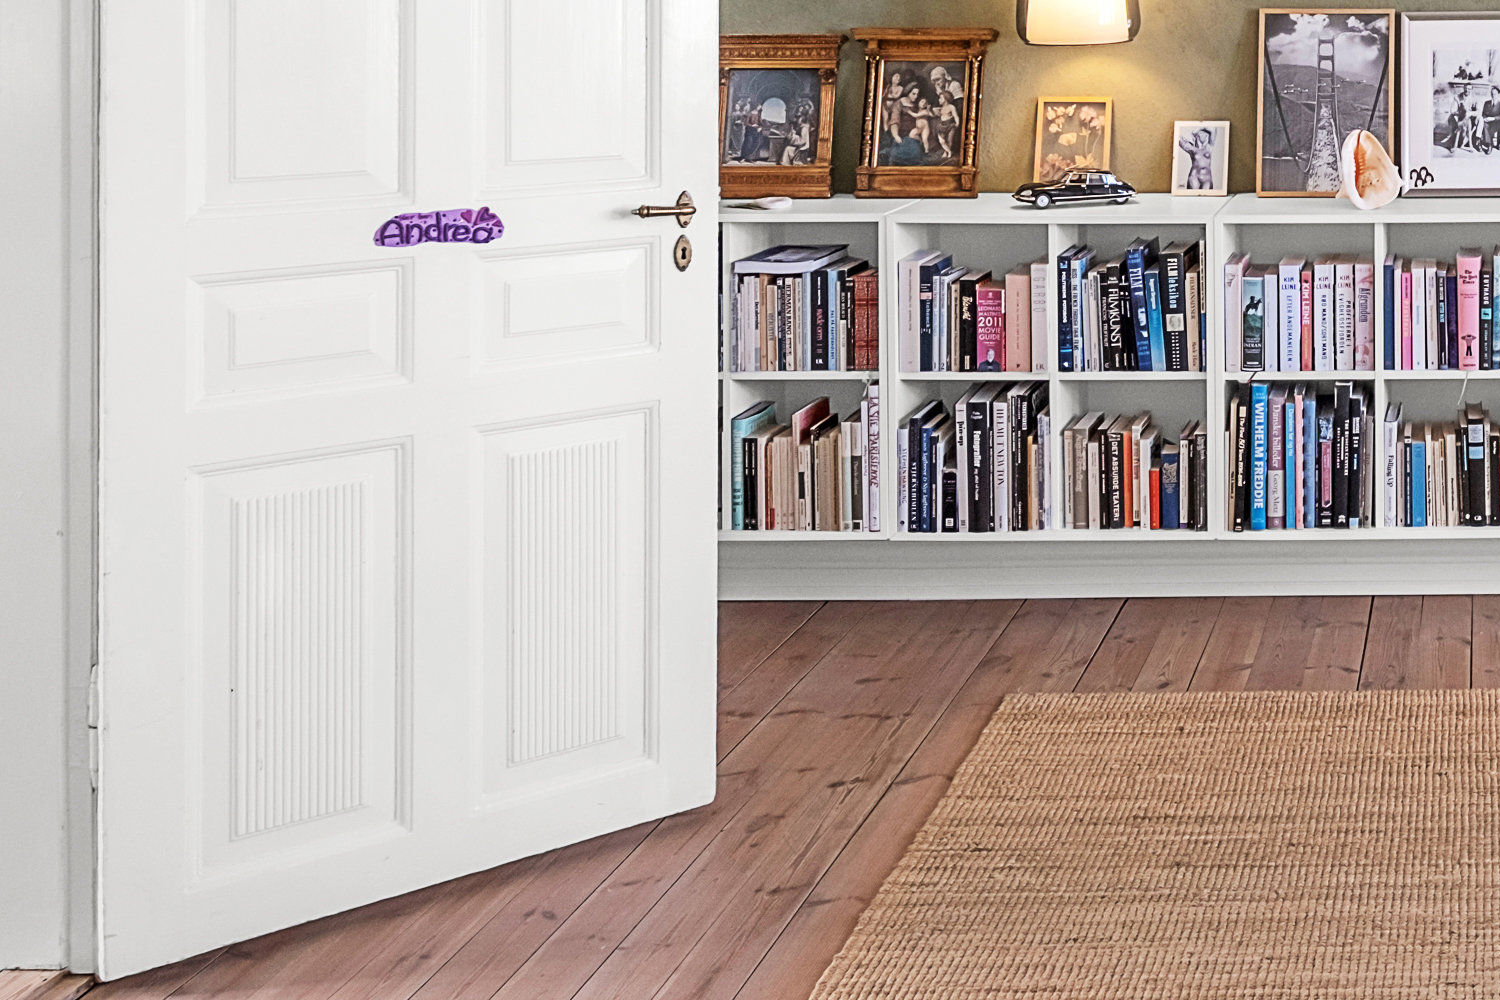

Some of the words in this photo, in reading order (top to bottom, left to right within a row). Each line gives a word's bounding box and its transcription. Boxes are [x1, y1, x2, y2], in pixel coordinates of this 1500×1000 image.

[380, 211, 494, 246] Andrea
[1302, 282, 1310, 299] KIM
[1357, 287, 1371, 323] Afgrunden
[978, 317, 1002, 327] 2011
[1107, 288, 1122, 349] FILMKUNST
[1302, 301, 1310, 325] LEINE
[869, 396, 880, 410] LA
[997, 408, 1005, 448] HELMUT
[1254, 402, 1265, 458] WILHELM
[1272, 404, 1281, 436] Danske
[1238, 439, 1246, 449] 50
[1272, 437, 1281, 468] billeder
[996, 448, 1005, 488] NEWTON
[1386, 455, 1394, 478] Falling
[1254, 461, 1265, 510] FREDDIE
[1271, 474, 1281, 496] Georg
[1273, 497, 1281, 514] Metz
